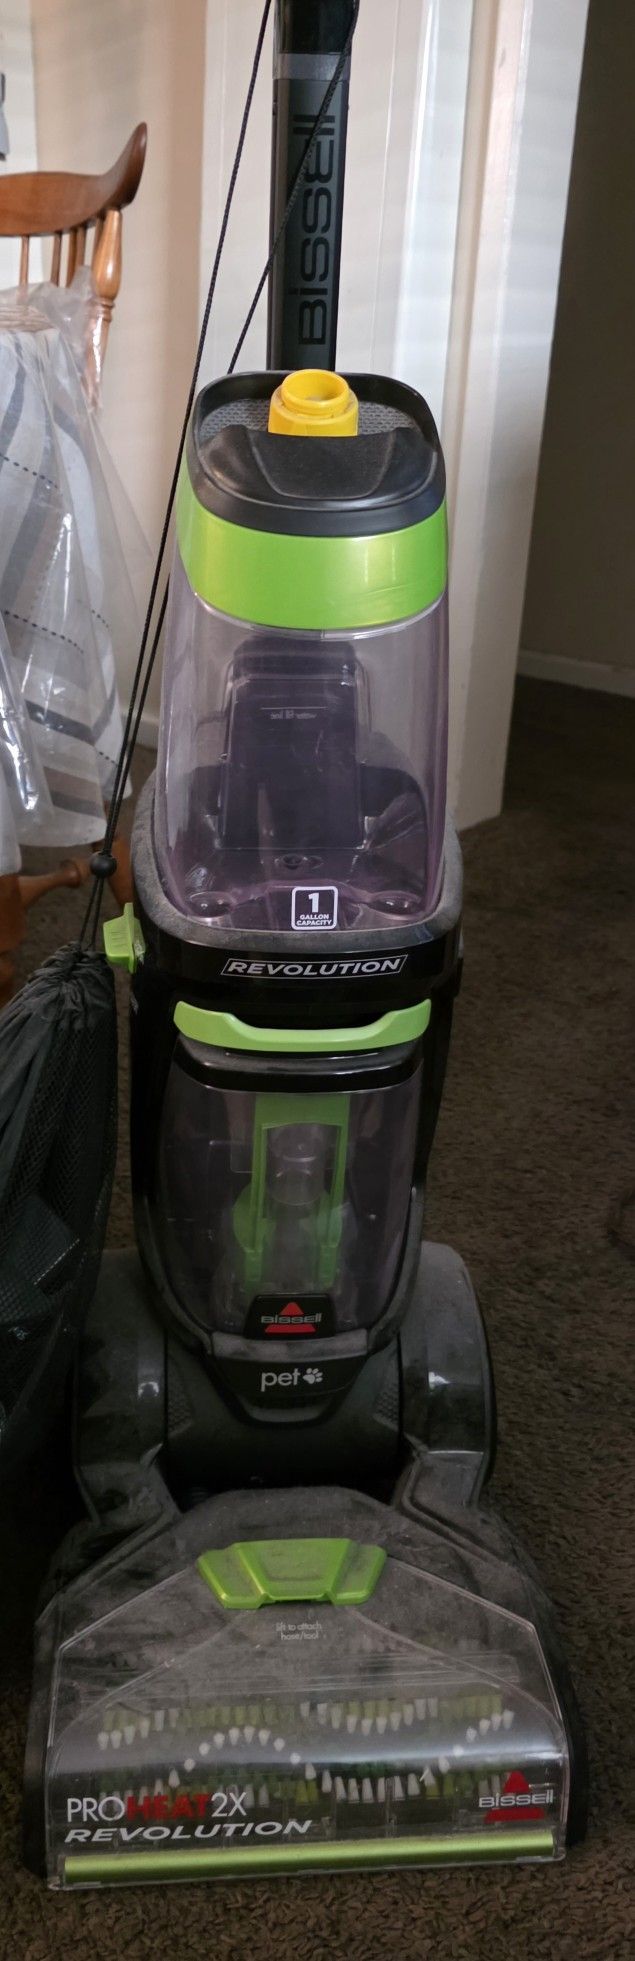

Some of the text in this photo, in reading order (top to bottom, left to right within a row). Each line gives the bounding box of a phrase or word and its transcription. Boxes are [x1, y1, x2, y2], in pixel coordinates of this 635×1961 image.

[308, 892, 320, 913] 1
[227, 958, 401, 976] REVOLUTION
[261, 1368, 301, 1392] pet
[64, 1820, 313, 1843] REVOLUTION
